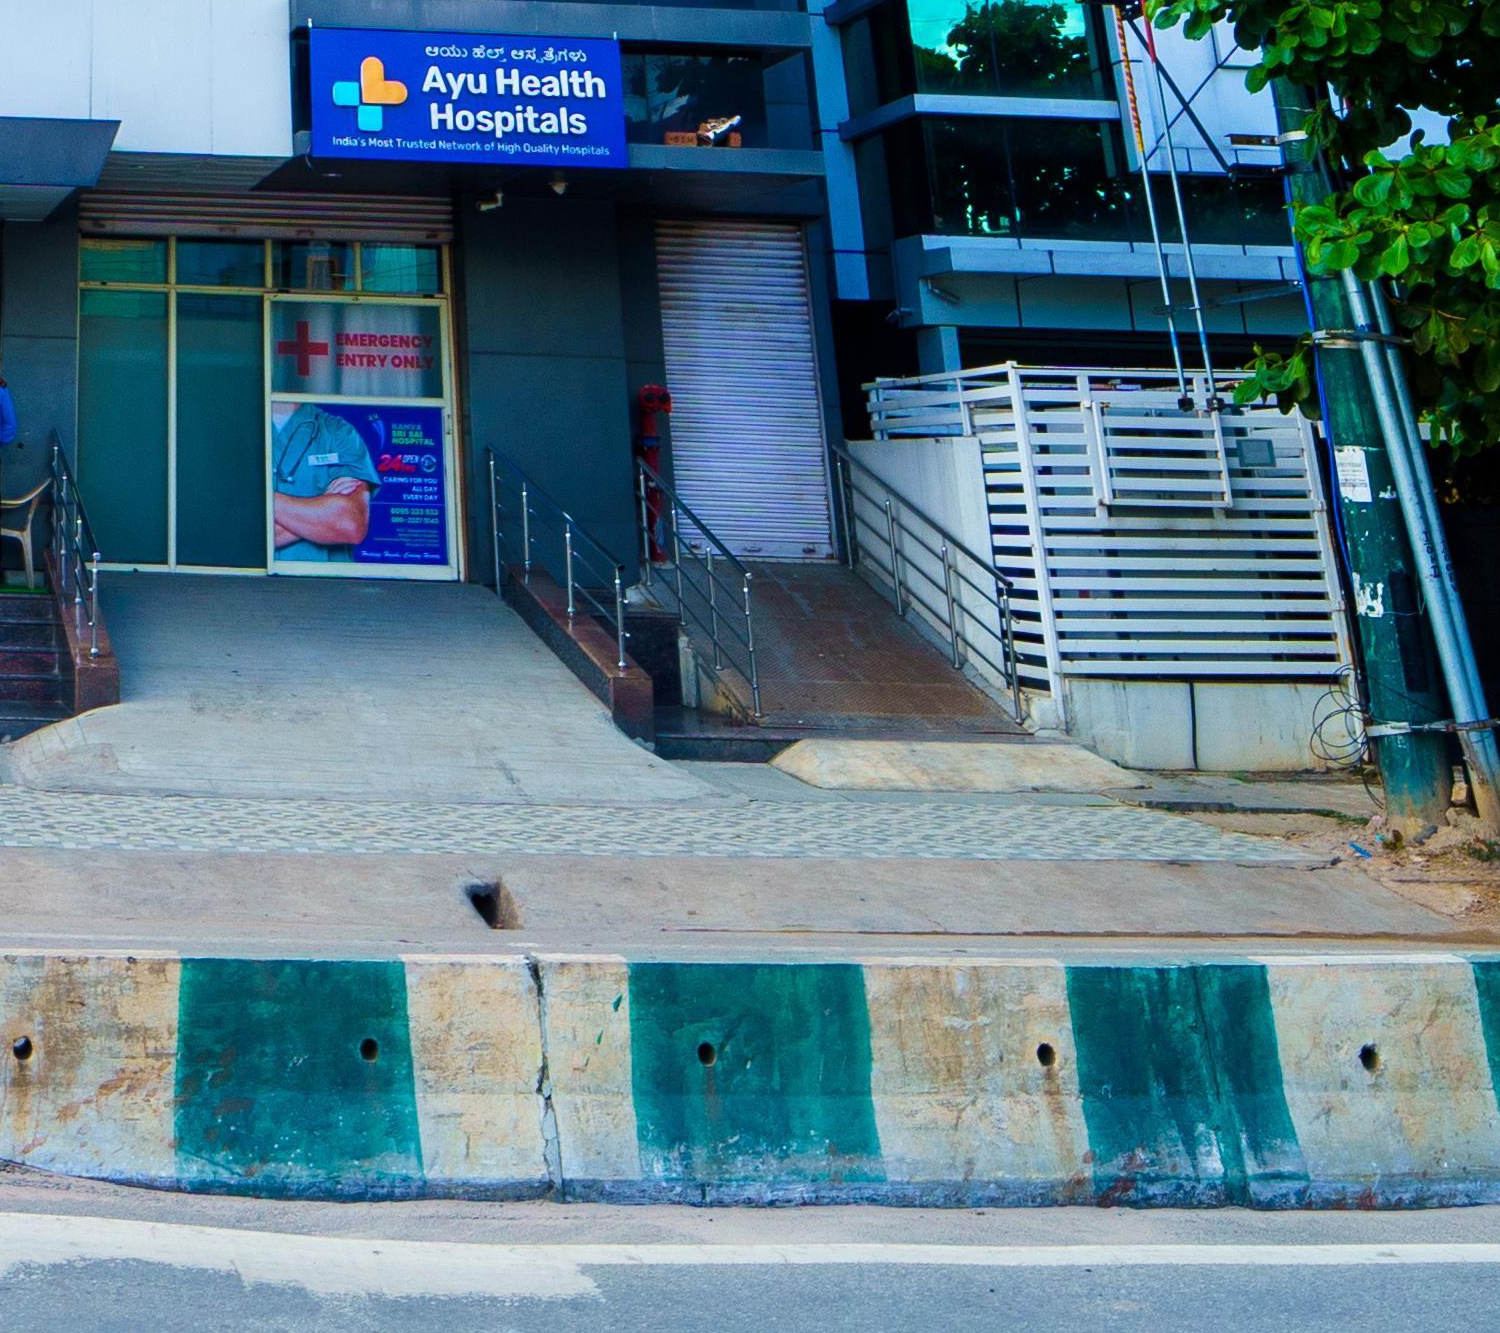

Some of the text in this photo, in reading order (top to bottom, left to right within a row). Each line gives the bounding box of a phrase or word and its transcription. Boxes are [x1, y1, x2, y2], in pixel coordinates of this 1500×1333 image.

[422, 65, 607, 100] Ayu Health
[429, 102, 588, 139] Hospitals
[332, 135, 611, 157] India's Most Trusted Network of High Quality Hospitals
[335, 332, 434, 349] EMERGENCY
[335, 353, 434, 370] ENTRY ONLY
